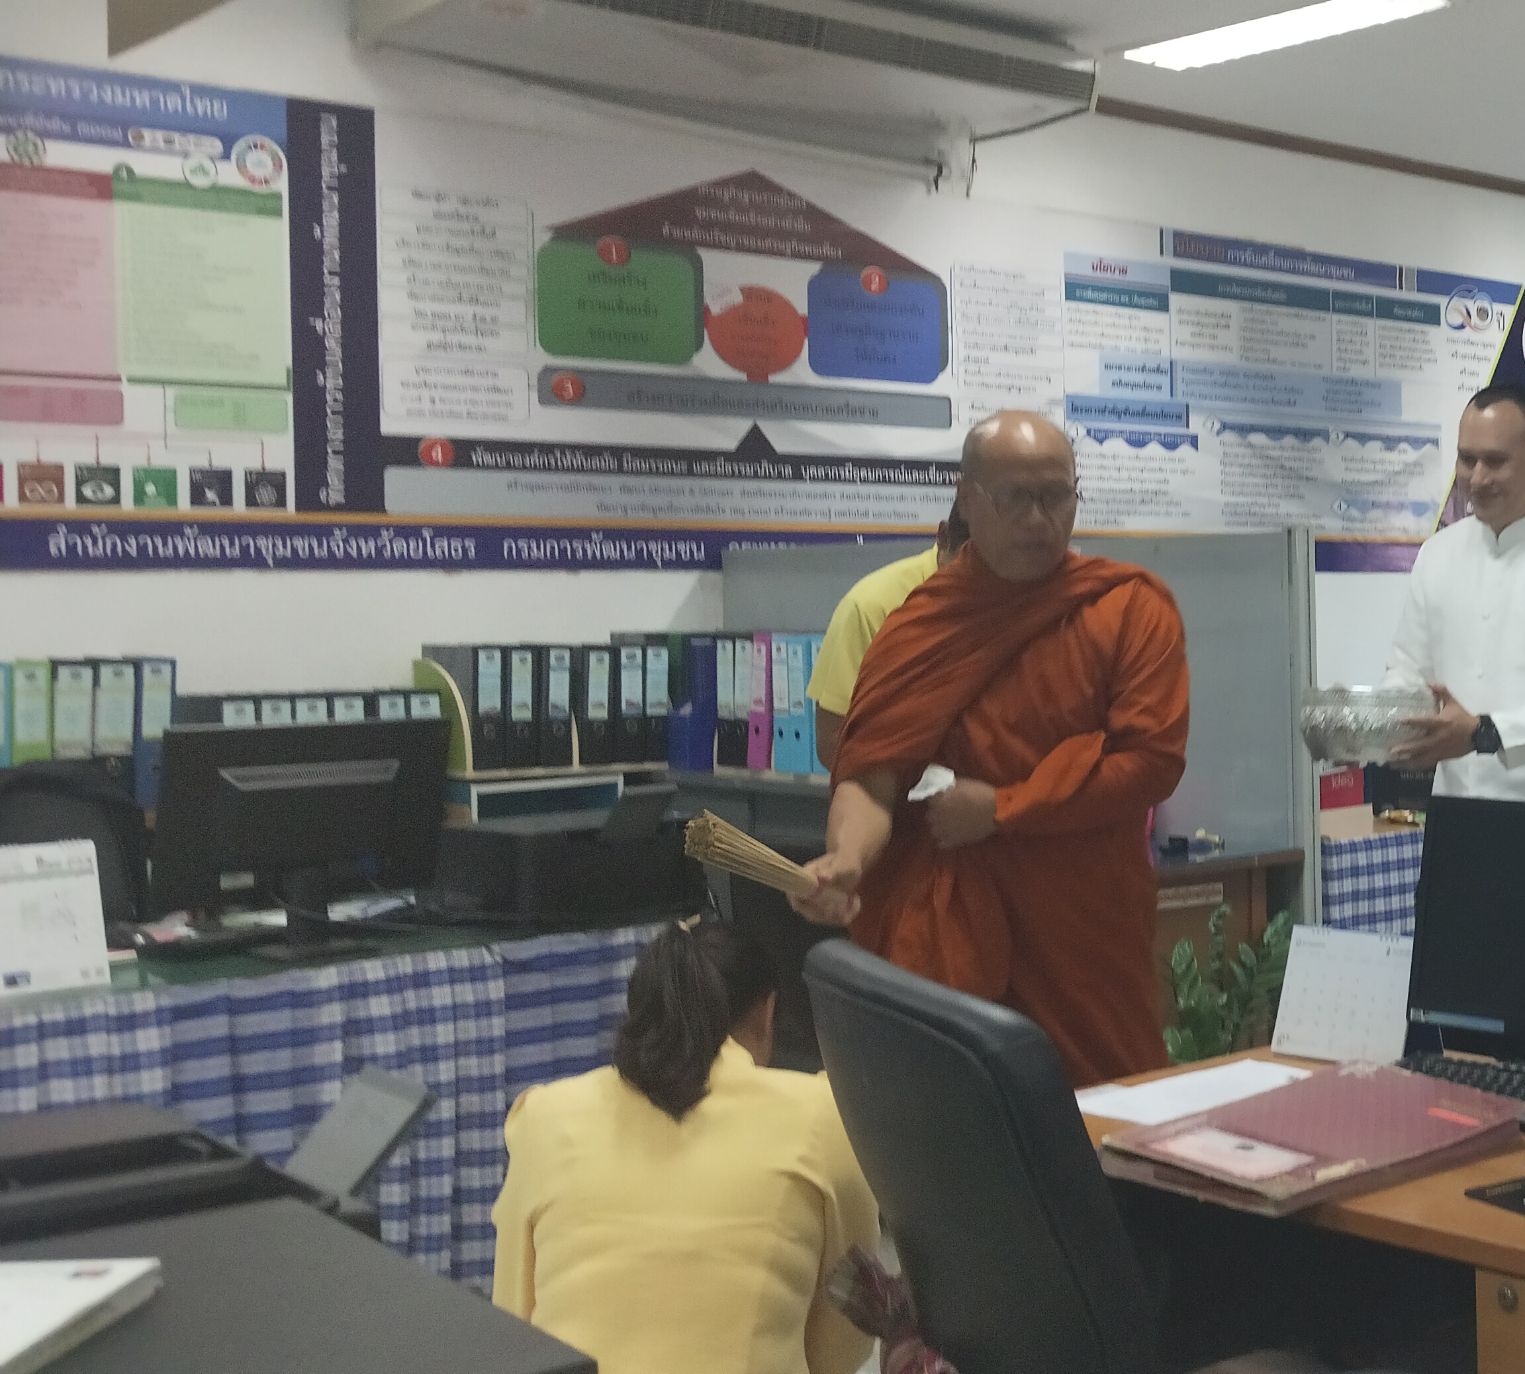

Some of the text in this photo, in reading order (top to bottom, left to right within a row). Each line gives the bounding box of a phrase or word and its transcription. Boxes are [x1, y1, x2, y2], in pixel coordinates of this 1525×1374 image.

[48, 524, 705, 569] สำนักงานพัฒนาชุมชนจังหวัดยโสธร กรมการพัฒนาชุมชน
